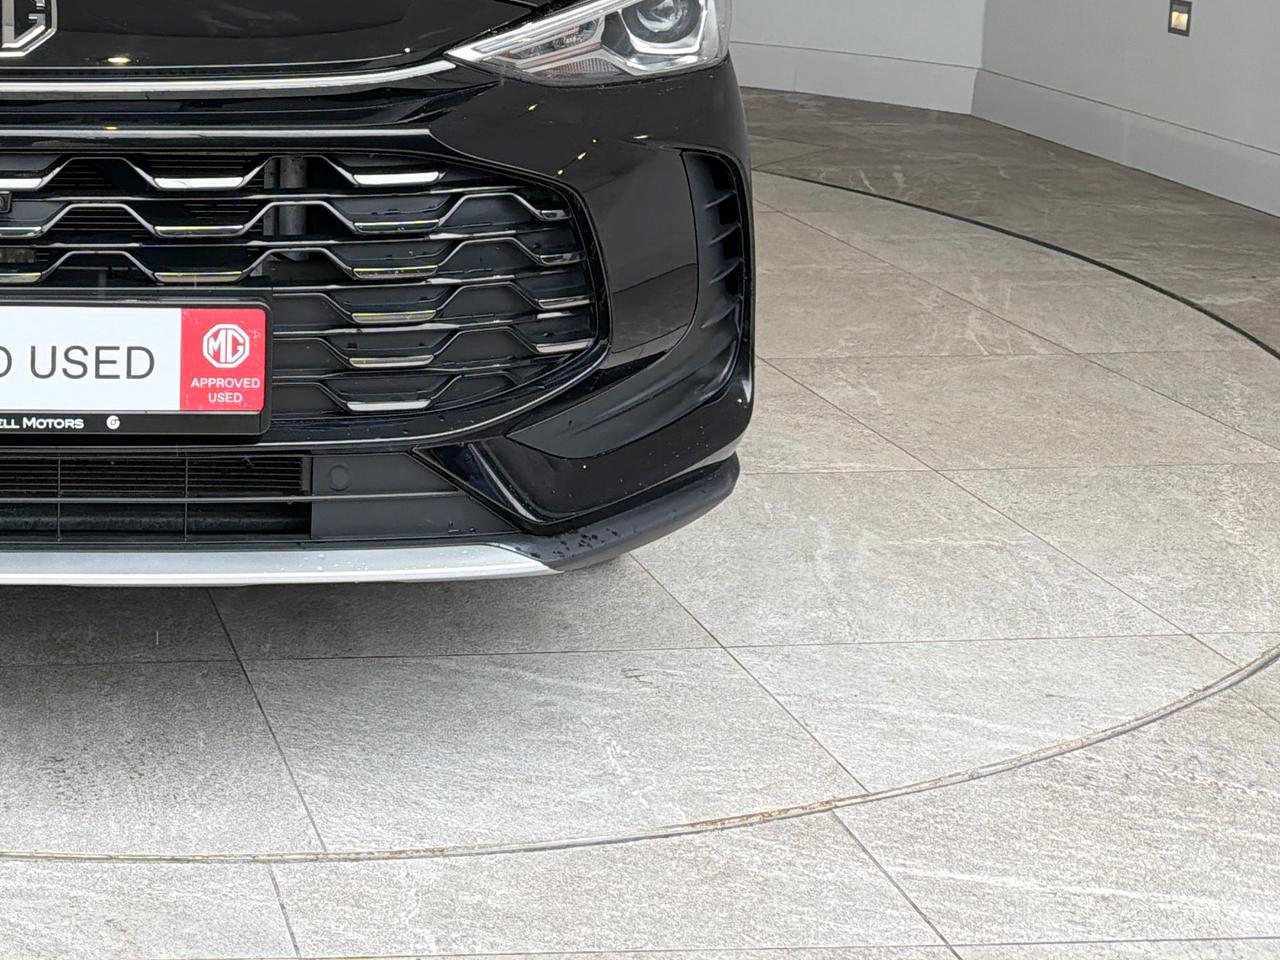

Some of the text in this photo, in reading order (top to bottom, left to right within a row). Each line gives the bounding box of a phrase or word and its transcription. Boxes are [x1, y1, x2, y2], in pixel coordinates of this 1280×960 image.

[207, 328, 245, 364] MG
[30, 345, 156, 381] USED
[190, 377, 261, 389] APPROVED
[208, 392, 243, 403] USED
[22, 416, 85, 430] MOTORS
